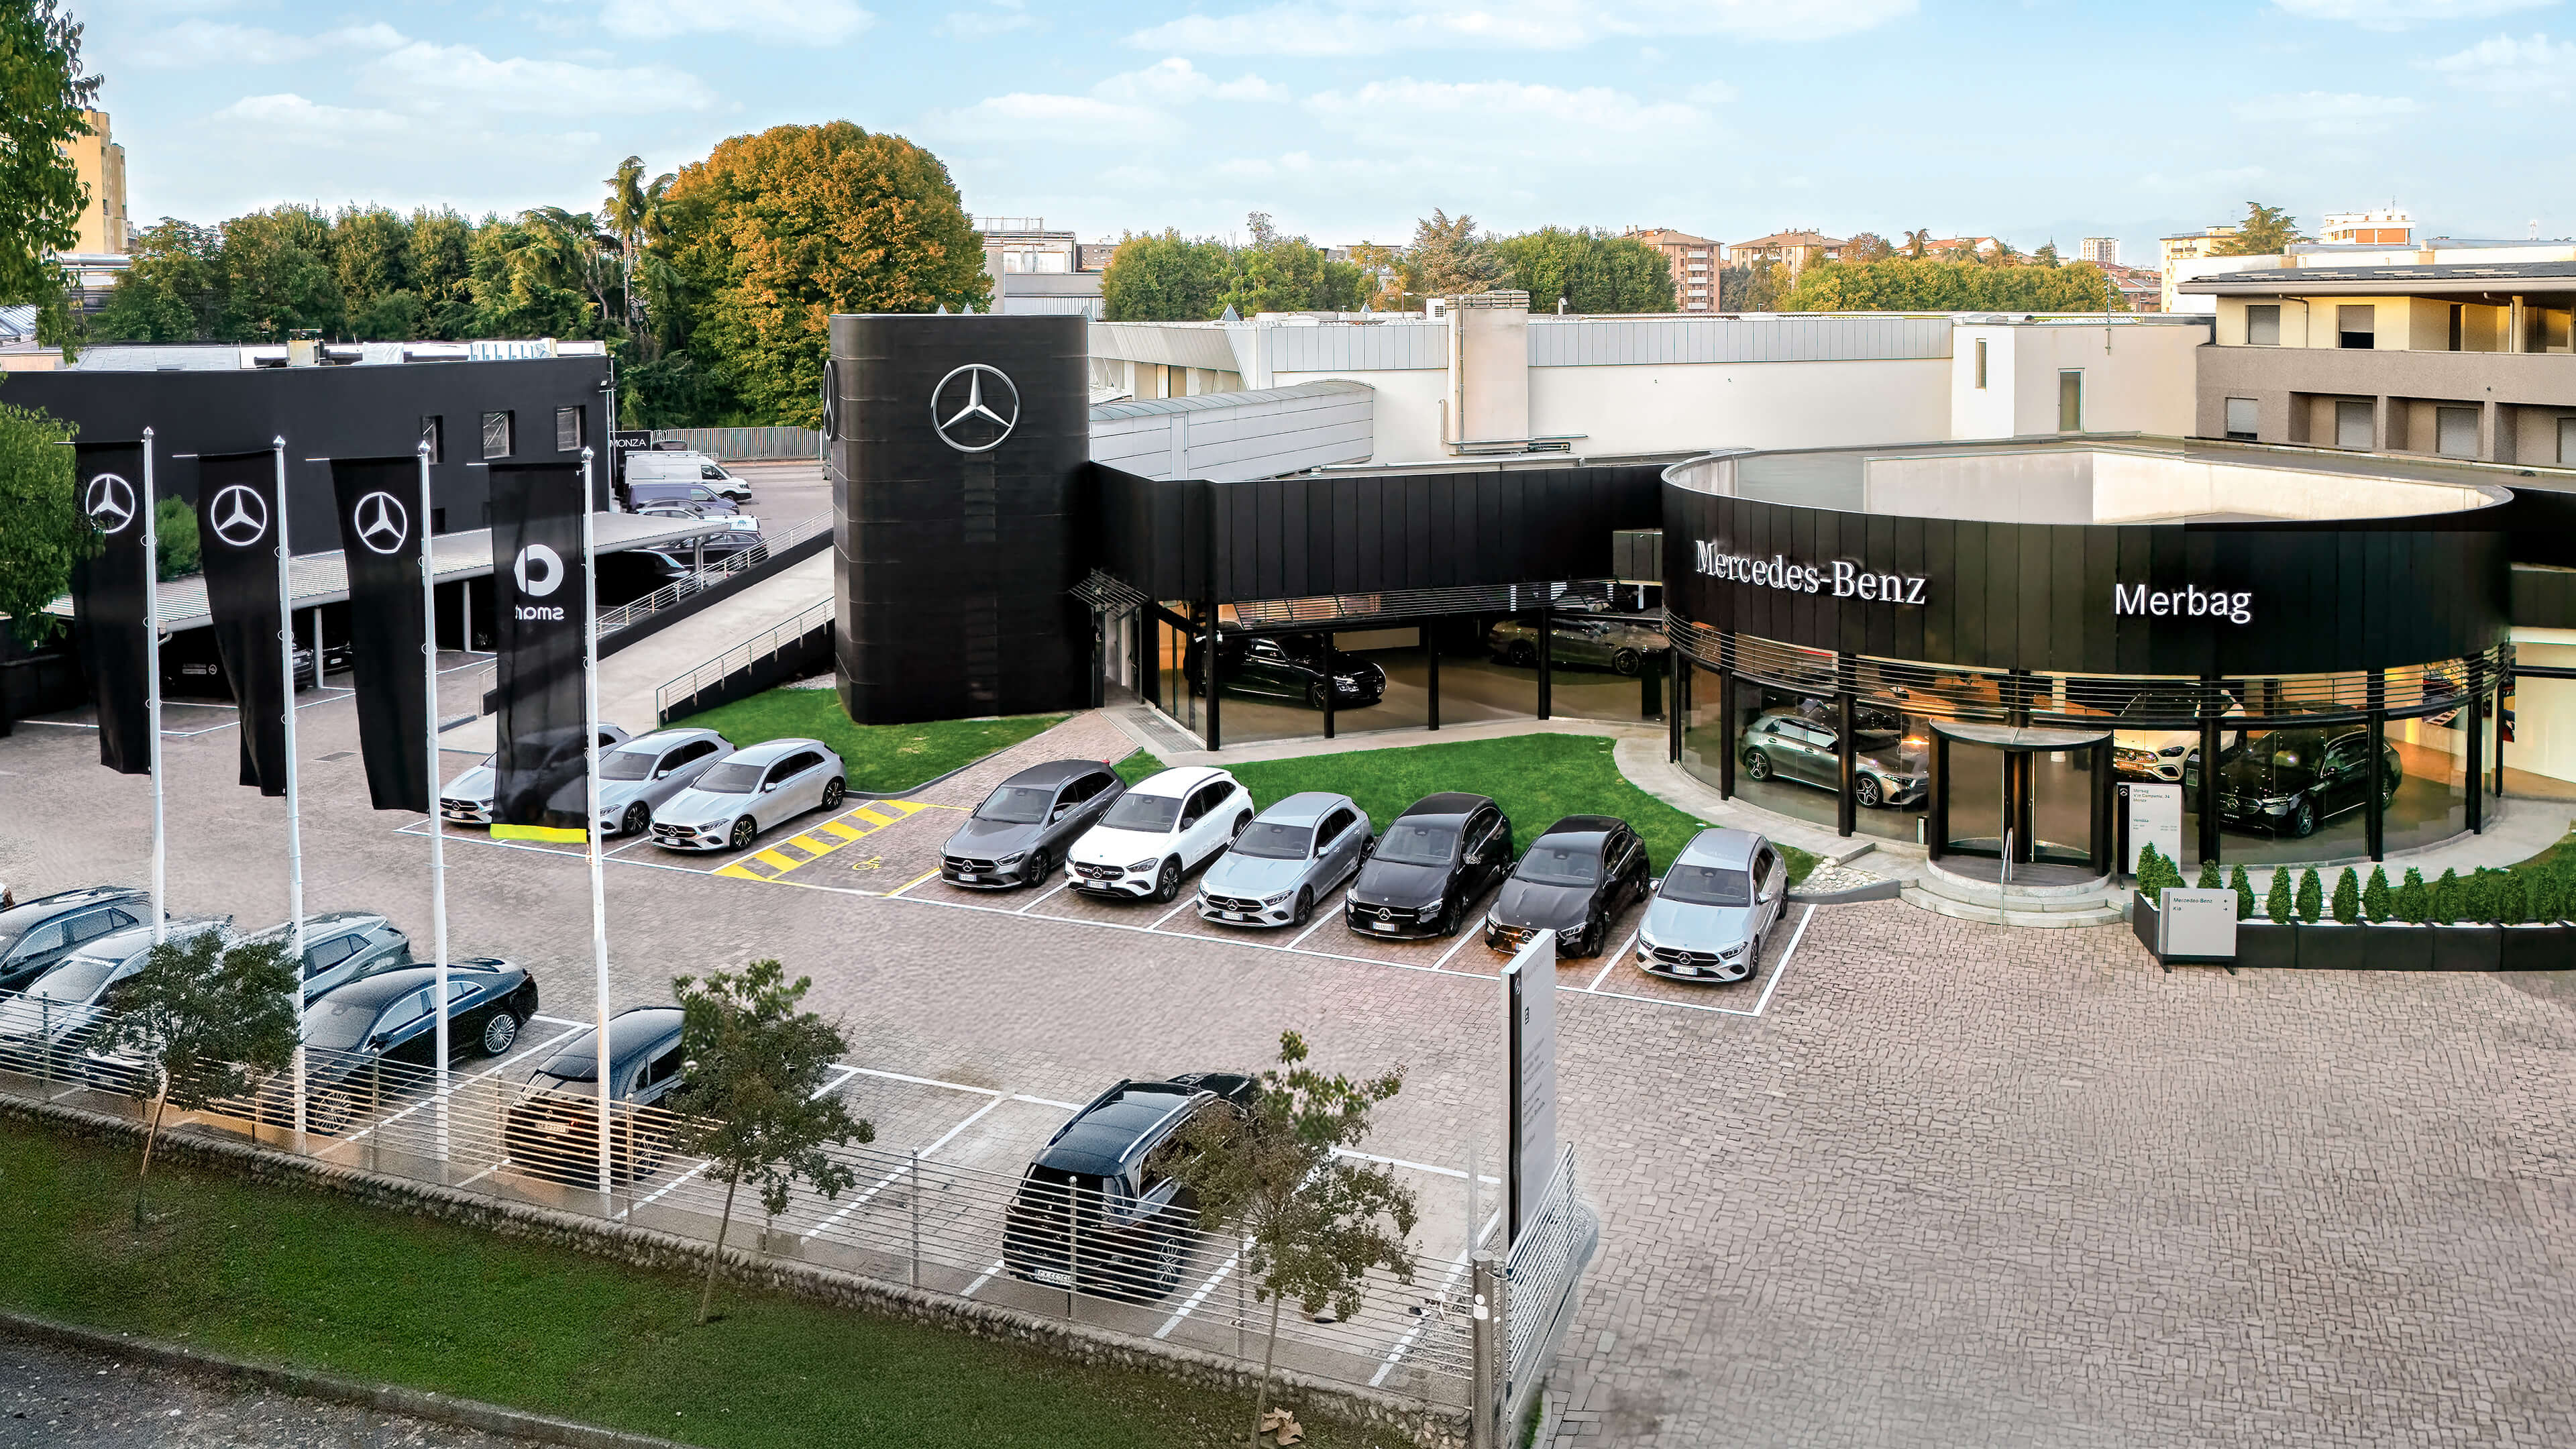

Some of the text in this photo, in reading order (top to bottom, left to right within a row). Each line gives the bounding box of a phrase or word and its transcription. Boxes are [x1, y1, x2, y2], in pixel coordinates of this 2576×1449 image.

[610, 439, 647, 447] MONZA
[1696, 540, 1926, 604] Mercedes-Benz
[2115, 584, 2252, 625] Merbag
